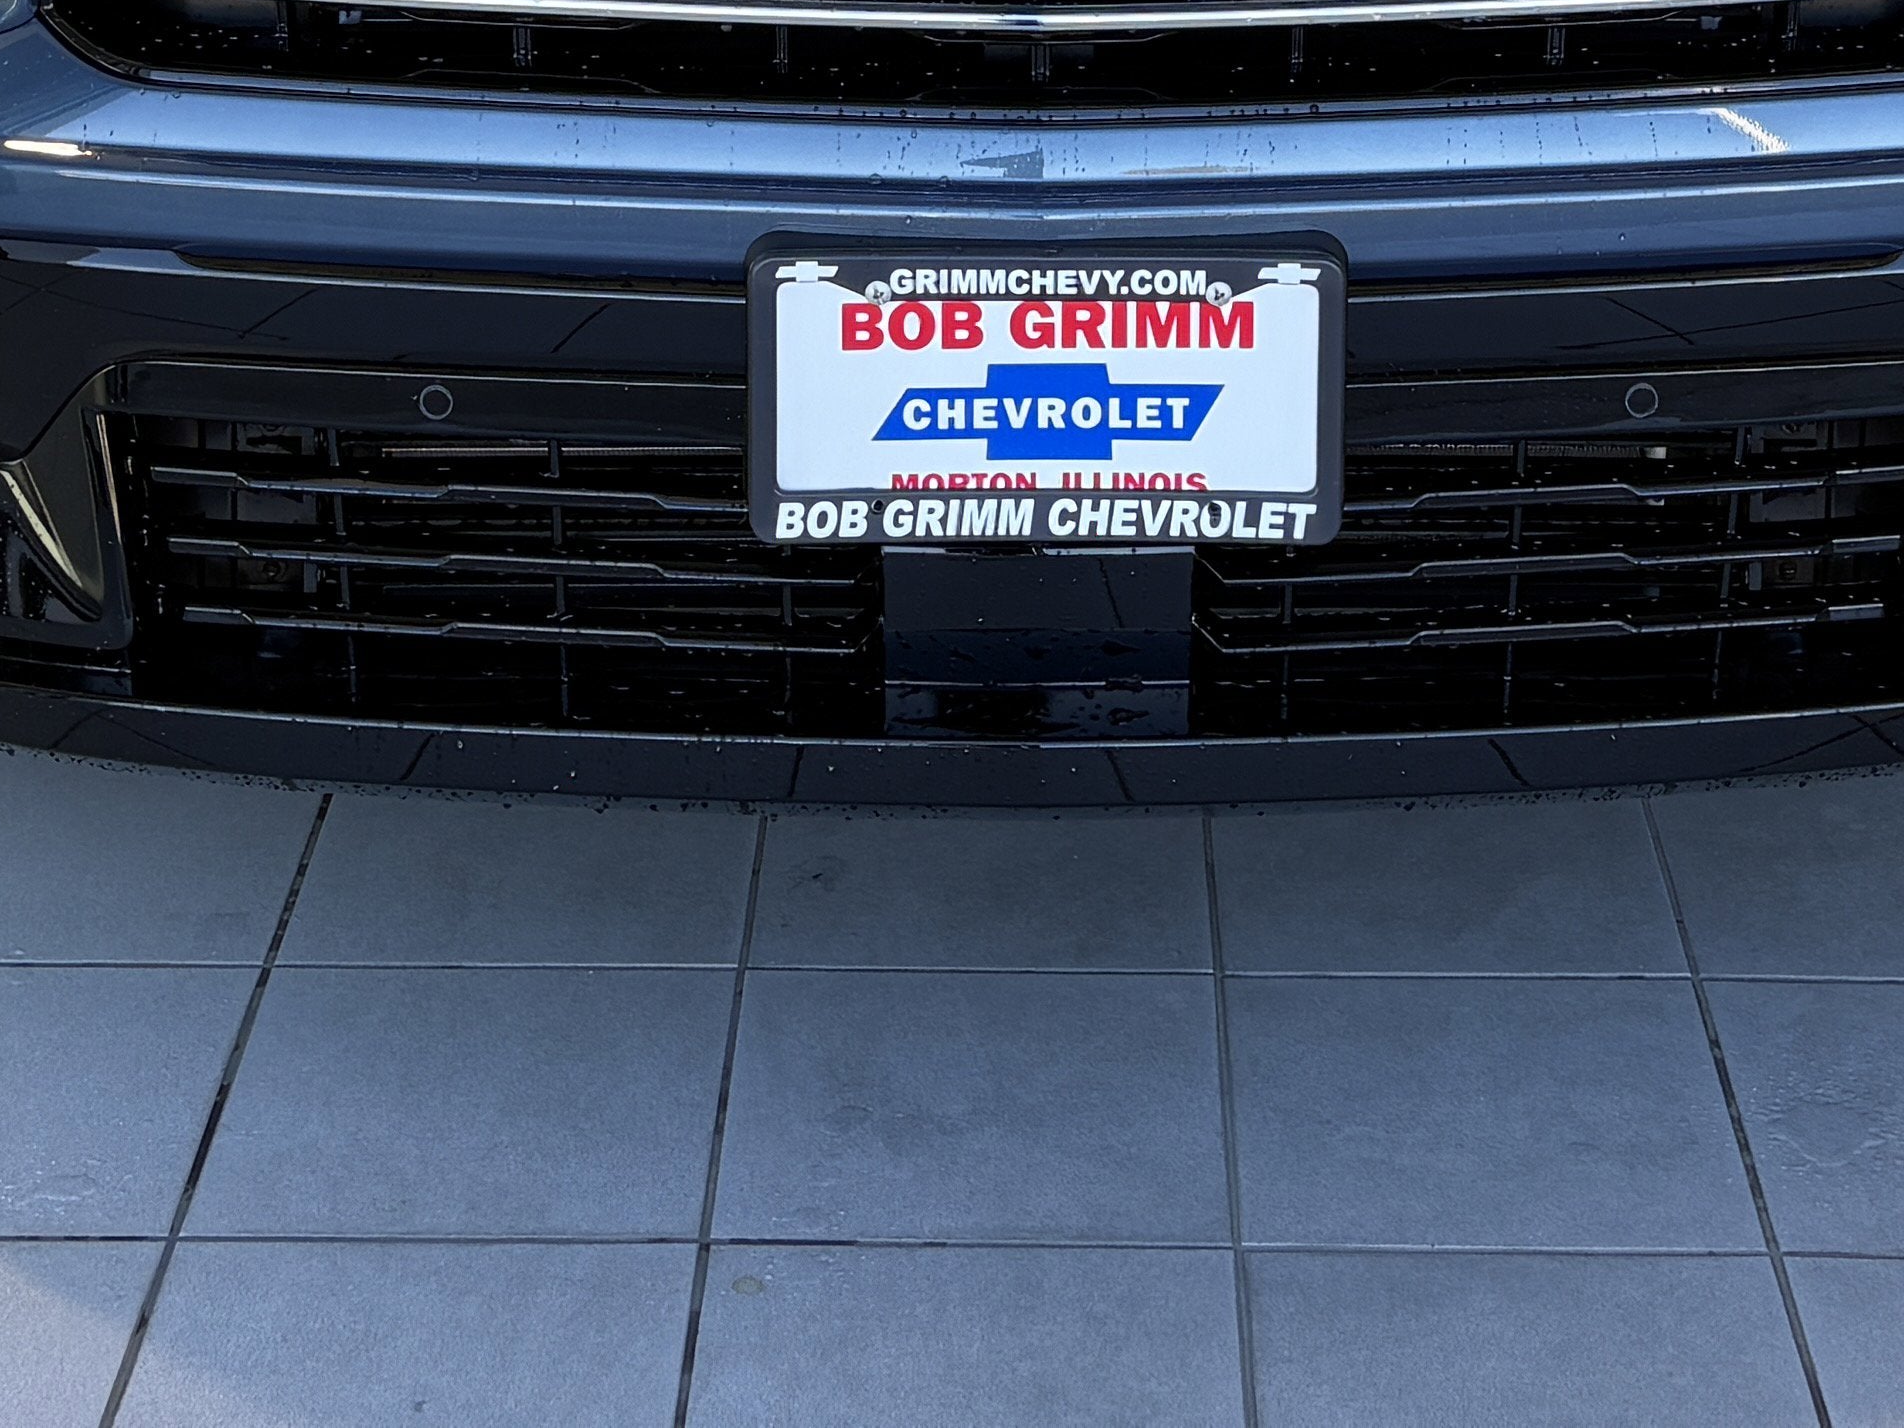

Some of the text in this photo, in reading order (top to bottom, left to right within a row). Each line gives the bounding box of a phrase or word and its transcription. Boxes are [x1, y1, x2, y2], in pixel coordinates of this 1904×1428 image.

[889, 268, 1209, 297] GRIMMCHEVY.COM
[841, 300, 1255, 351] BOB GRIMM
[902, 396, 1190, 430] CHEVROLET
[776, 499, 1317, 540] BOB GRIMM CHEVROLET
